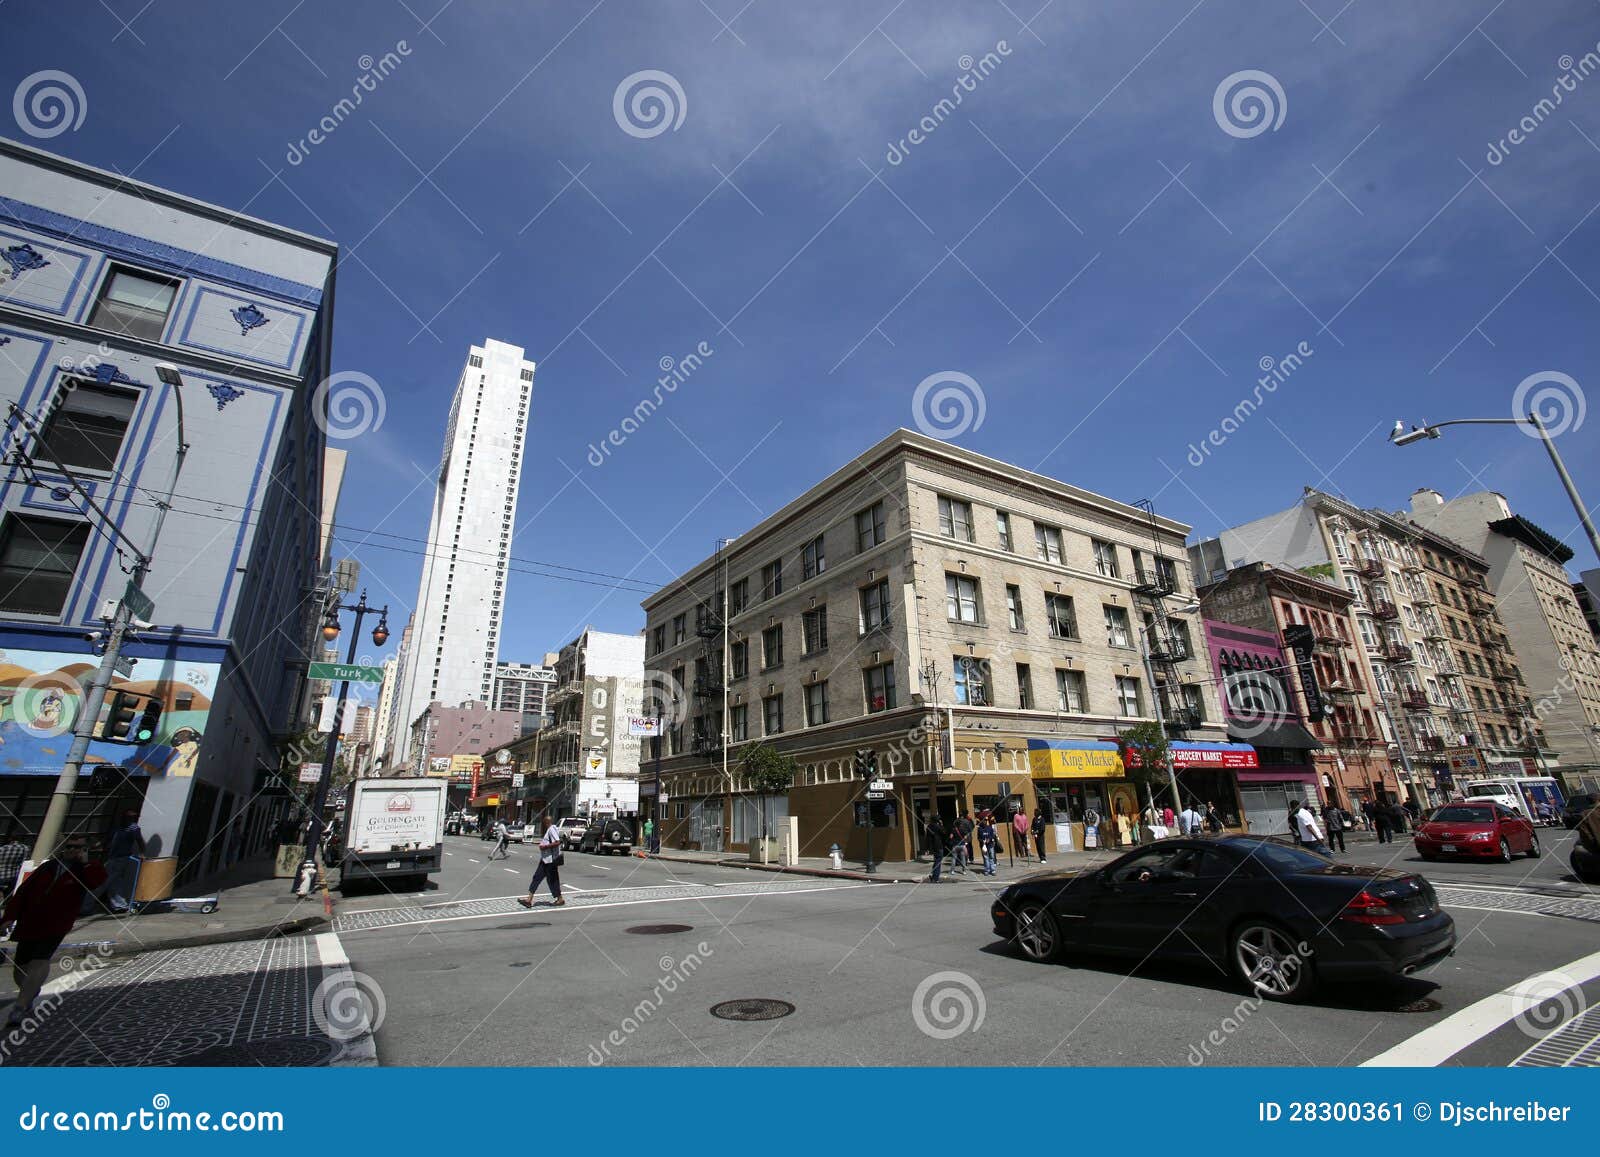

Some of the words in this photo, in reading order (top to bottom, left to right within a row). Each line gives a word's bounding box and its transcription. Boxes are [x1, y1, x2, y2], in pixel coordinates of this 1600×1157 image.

[333, 667, 361, 679] Turk
[1061, 751, 1083, 770] King
[1084, 751, 1115, 767] Market
[1176, 751, 1202, 761] GROCERY
[1202, 751, 1223, 762] MARKET
